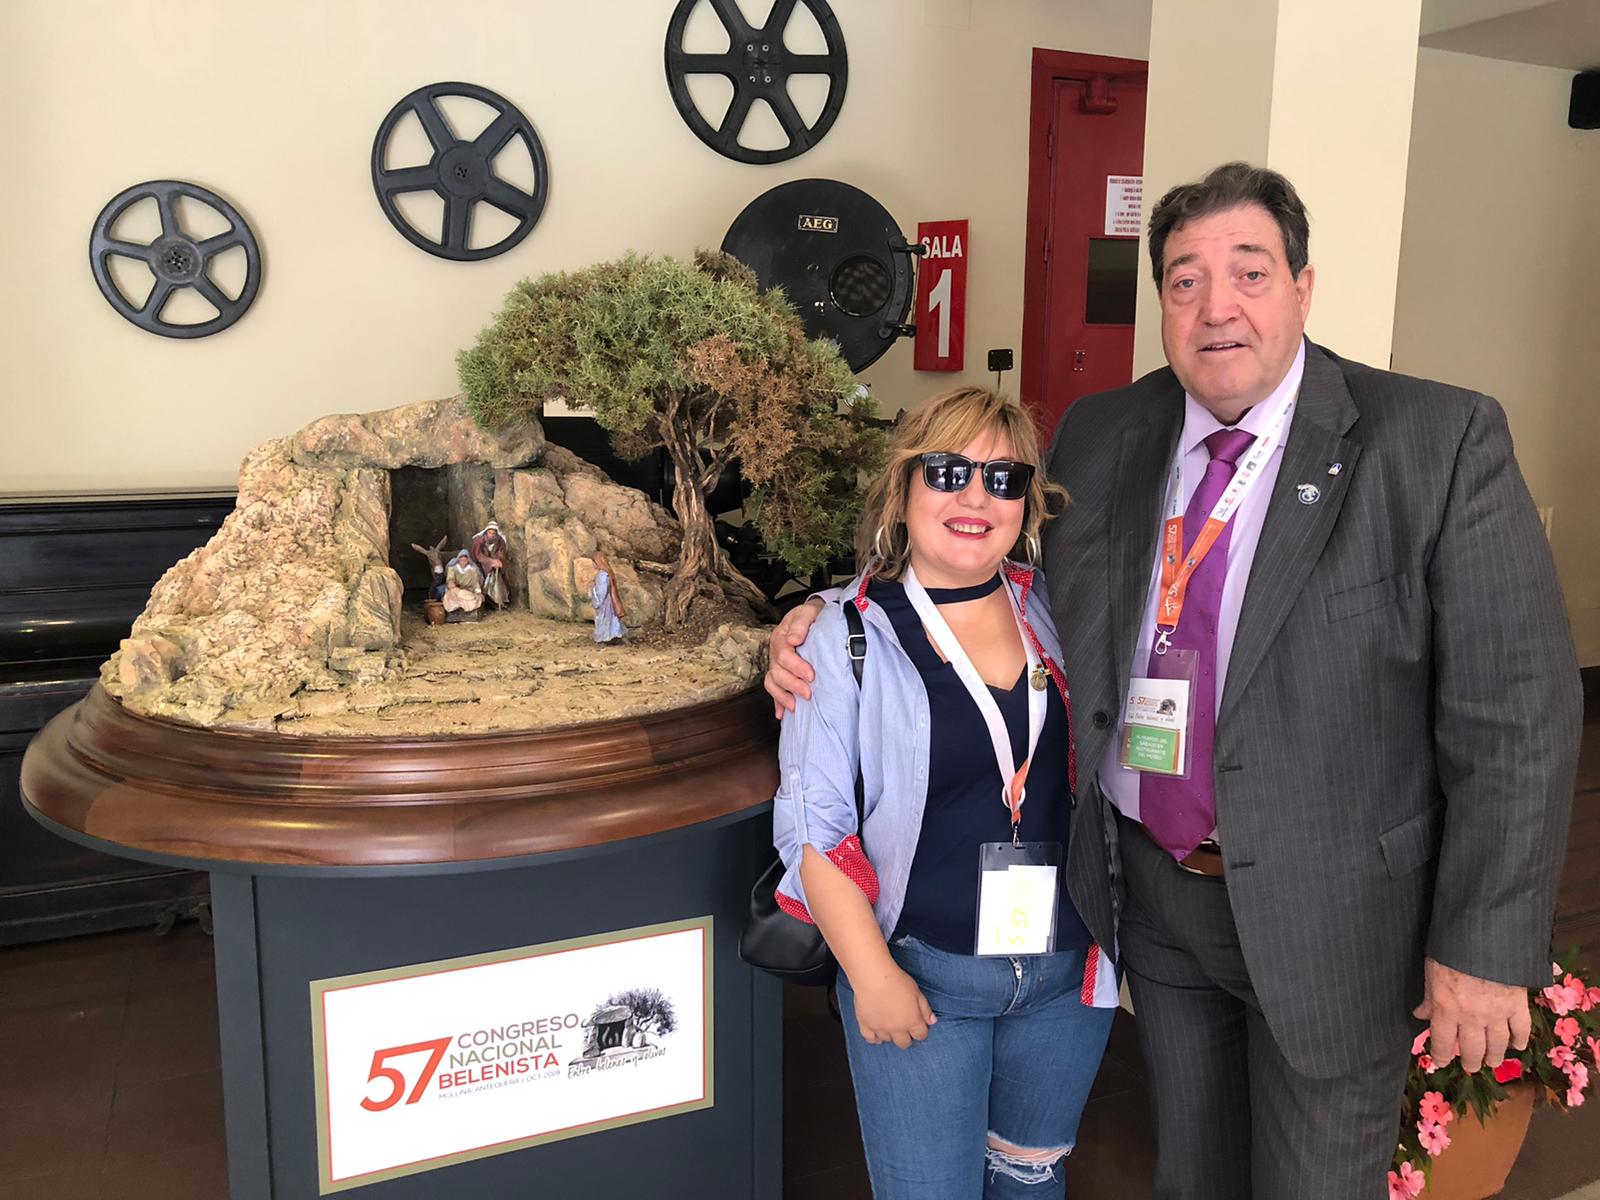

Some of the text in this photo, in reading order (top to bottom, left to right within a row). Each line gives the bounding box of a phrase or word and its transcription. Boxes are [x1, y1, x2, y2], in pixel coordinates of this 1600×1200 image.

[802, 218, 833, 230] AEG
[921, 234, 963, 259] SALA
[928, 269, 952, 358] 1
[457, 1013, 579, 1049] CONGRESO
[449, 1034, 562, 1069] NACIONAL
[360, 1036, 453, 1112] 57
[438, 1053, 559, 1090] BELENISTA
